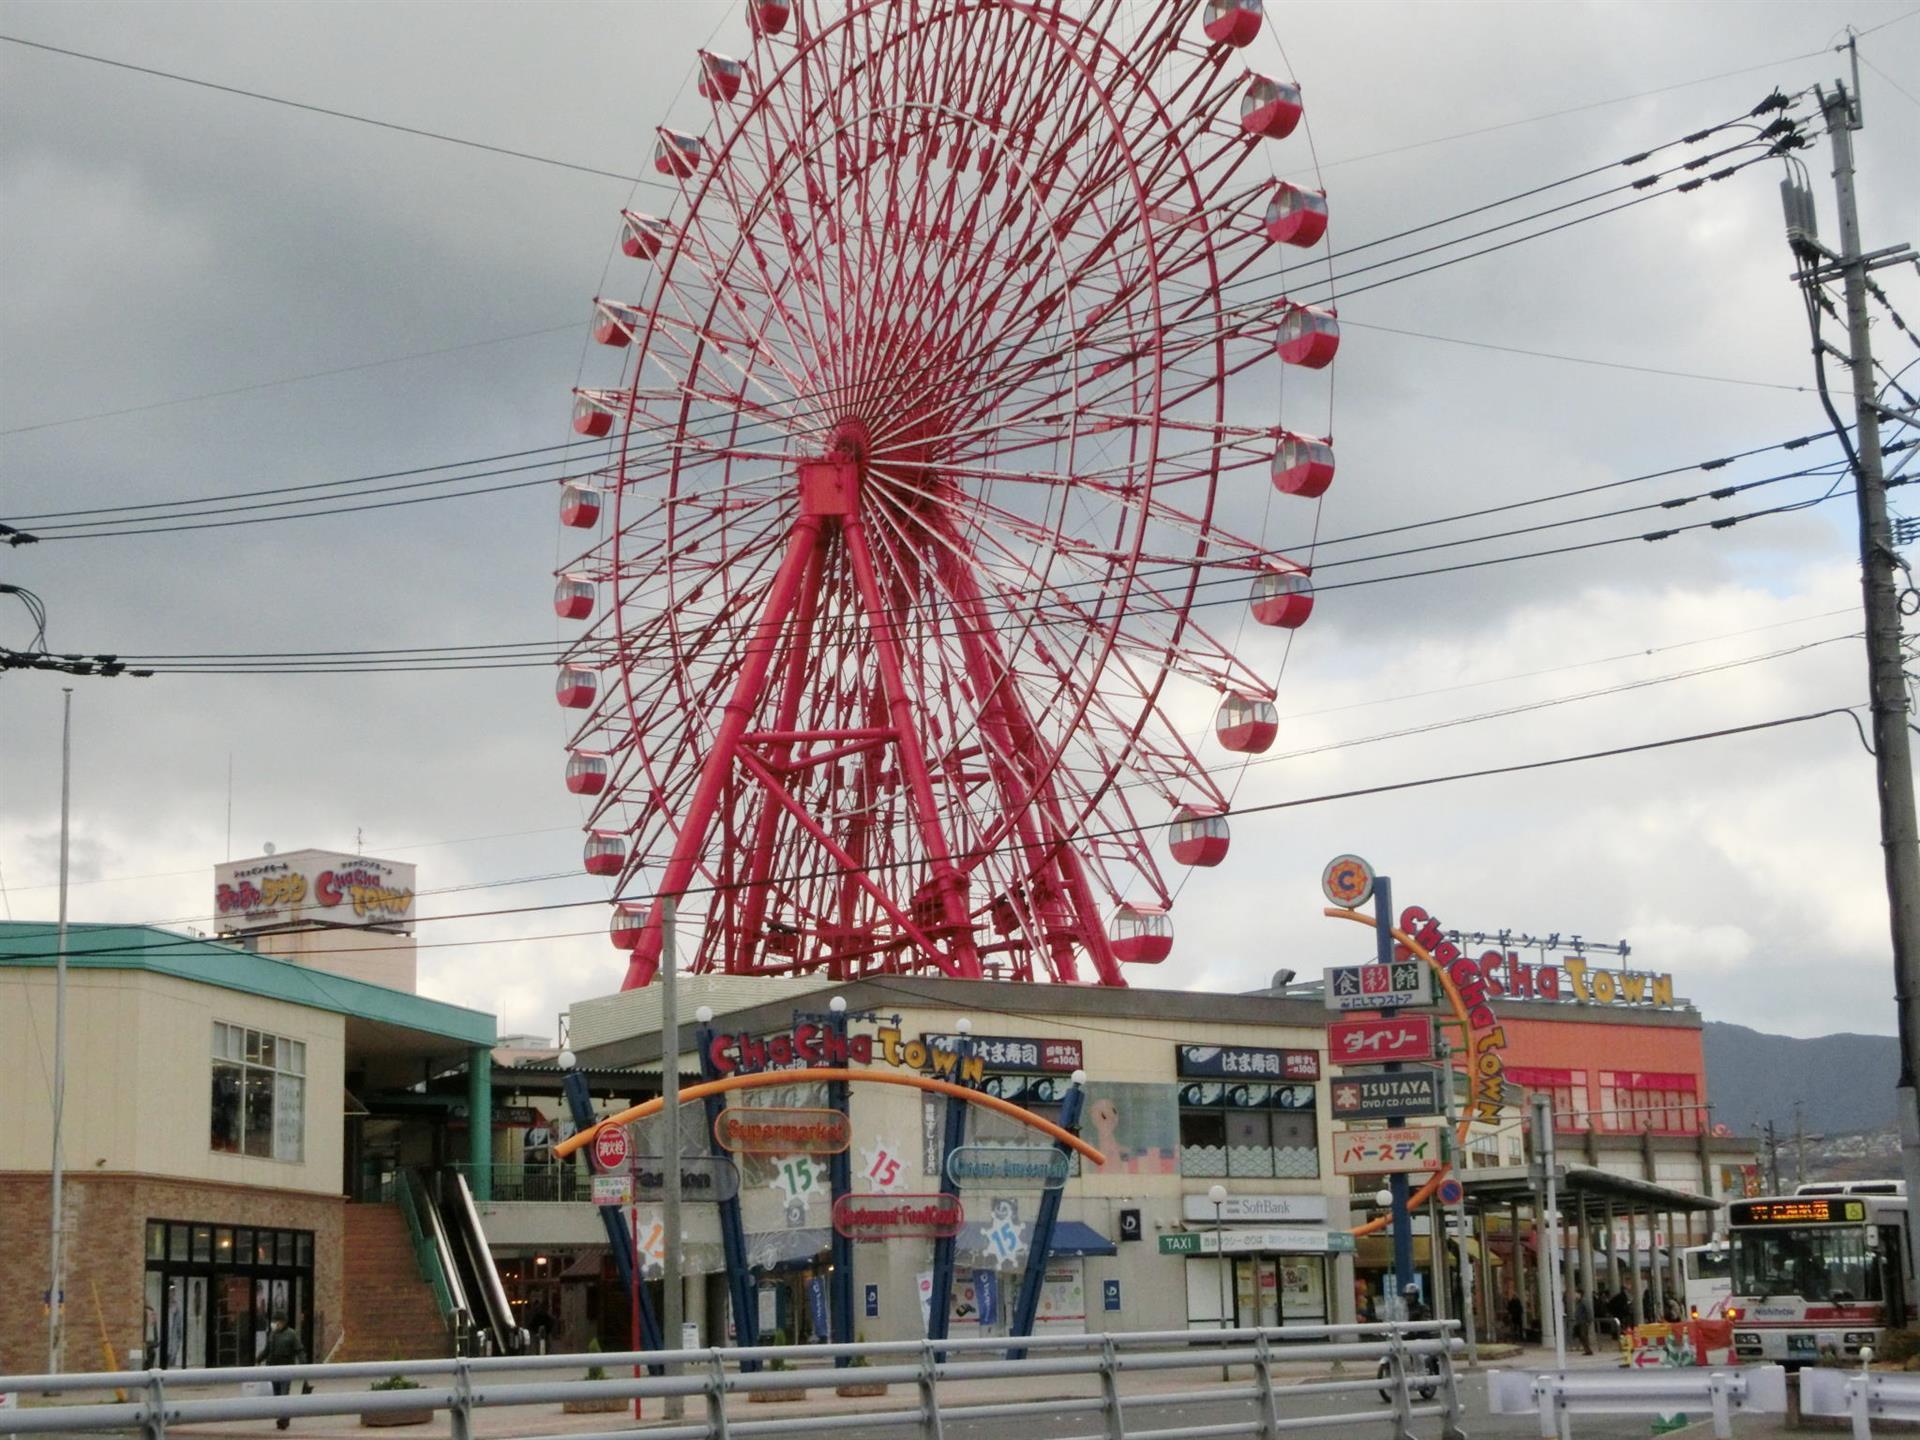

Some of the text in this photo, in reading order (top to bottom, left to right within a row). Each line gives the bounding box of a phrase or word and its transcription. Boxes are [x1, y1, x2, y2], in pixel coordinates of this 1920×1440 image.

[1449, 928, 1631, 956] ョッピングモール
[1335, 963, 1418, 995] 食彩館
[972, 1040, 1038, 1066] はま寿司
[1343, 1029, 1418, 1054] ダイソー
[1222, 1052, 1280, 1074] はま寿司
[1336, 1086, 1358, 1108] 本
[1361, 1080, 1431, 1097] TSUTAYA
[726, 1118, 844, 1141] Supermarket
[599, 1139, 625, 1156] 消火栓
[784, 1156, 813, 1195] 15
[869, 1150, 901, 1186] 15
[1242, 1200, 1291, 1214] SoftBank
[992, 1222, 1018, 1258] 15
[1166, 1237, 1192, 1249] TAXI
